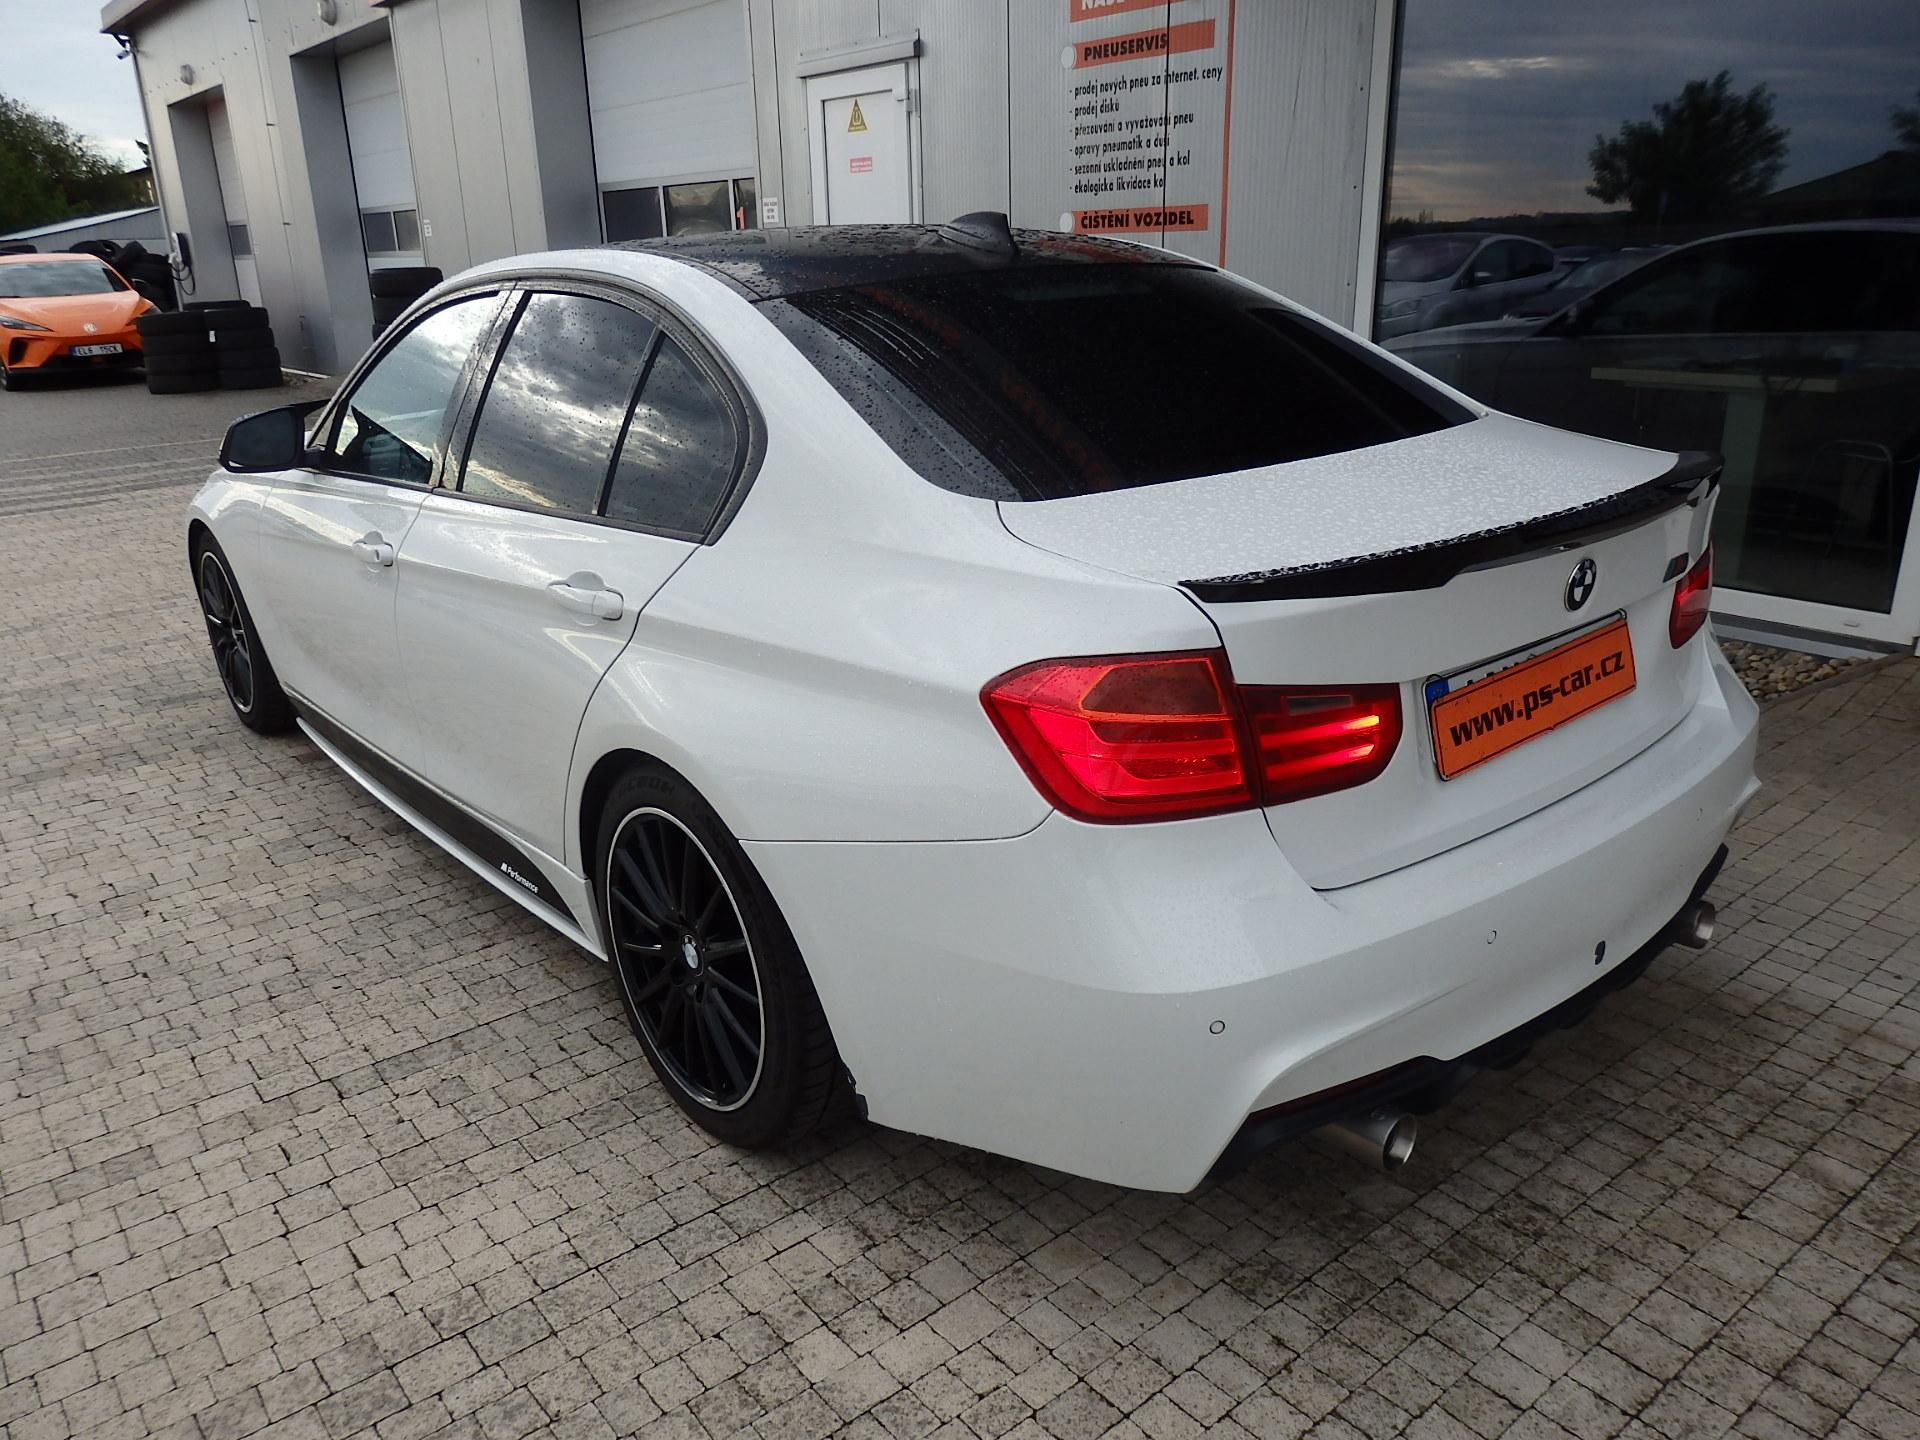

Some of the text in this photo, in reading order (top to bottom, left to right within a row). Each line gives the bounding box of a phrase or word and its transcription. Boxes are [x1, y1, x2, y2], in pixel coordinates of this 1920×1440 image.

[1084, 33, 1168, 61] PNEUSERVIS
[1075, 79, 1098, 100] prodej
[1130, 76, 1149, 93] pneu
[1151, 75, 1161, 86] za
[1202, 66, 1223, 82] ceny
[1075, 100, 1098, 120] prodej
[1118, 121, 1122, 131] a
[1173, 113, 1194, 129] pneu
[1075, 144, 1100, 159] opravy
[1103, 134, 1143, 157] pneumatik
[1146, 138, 1151, 148] a
[1169, 156, 1175, 166] a
[1177, 149, 1190, 166] kol
[1116, 175, 1151, 191] likvidace
[1081, 210, 1194, 229] ČIŠTĚNÍ VOZIDEL
[1450, 651, 1626, 746] www.ps-car.cz
